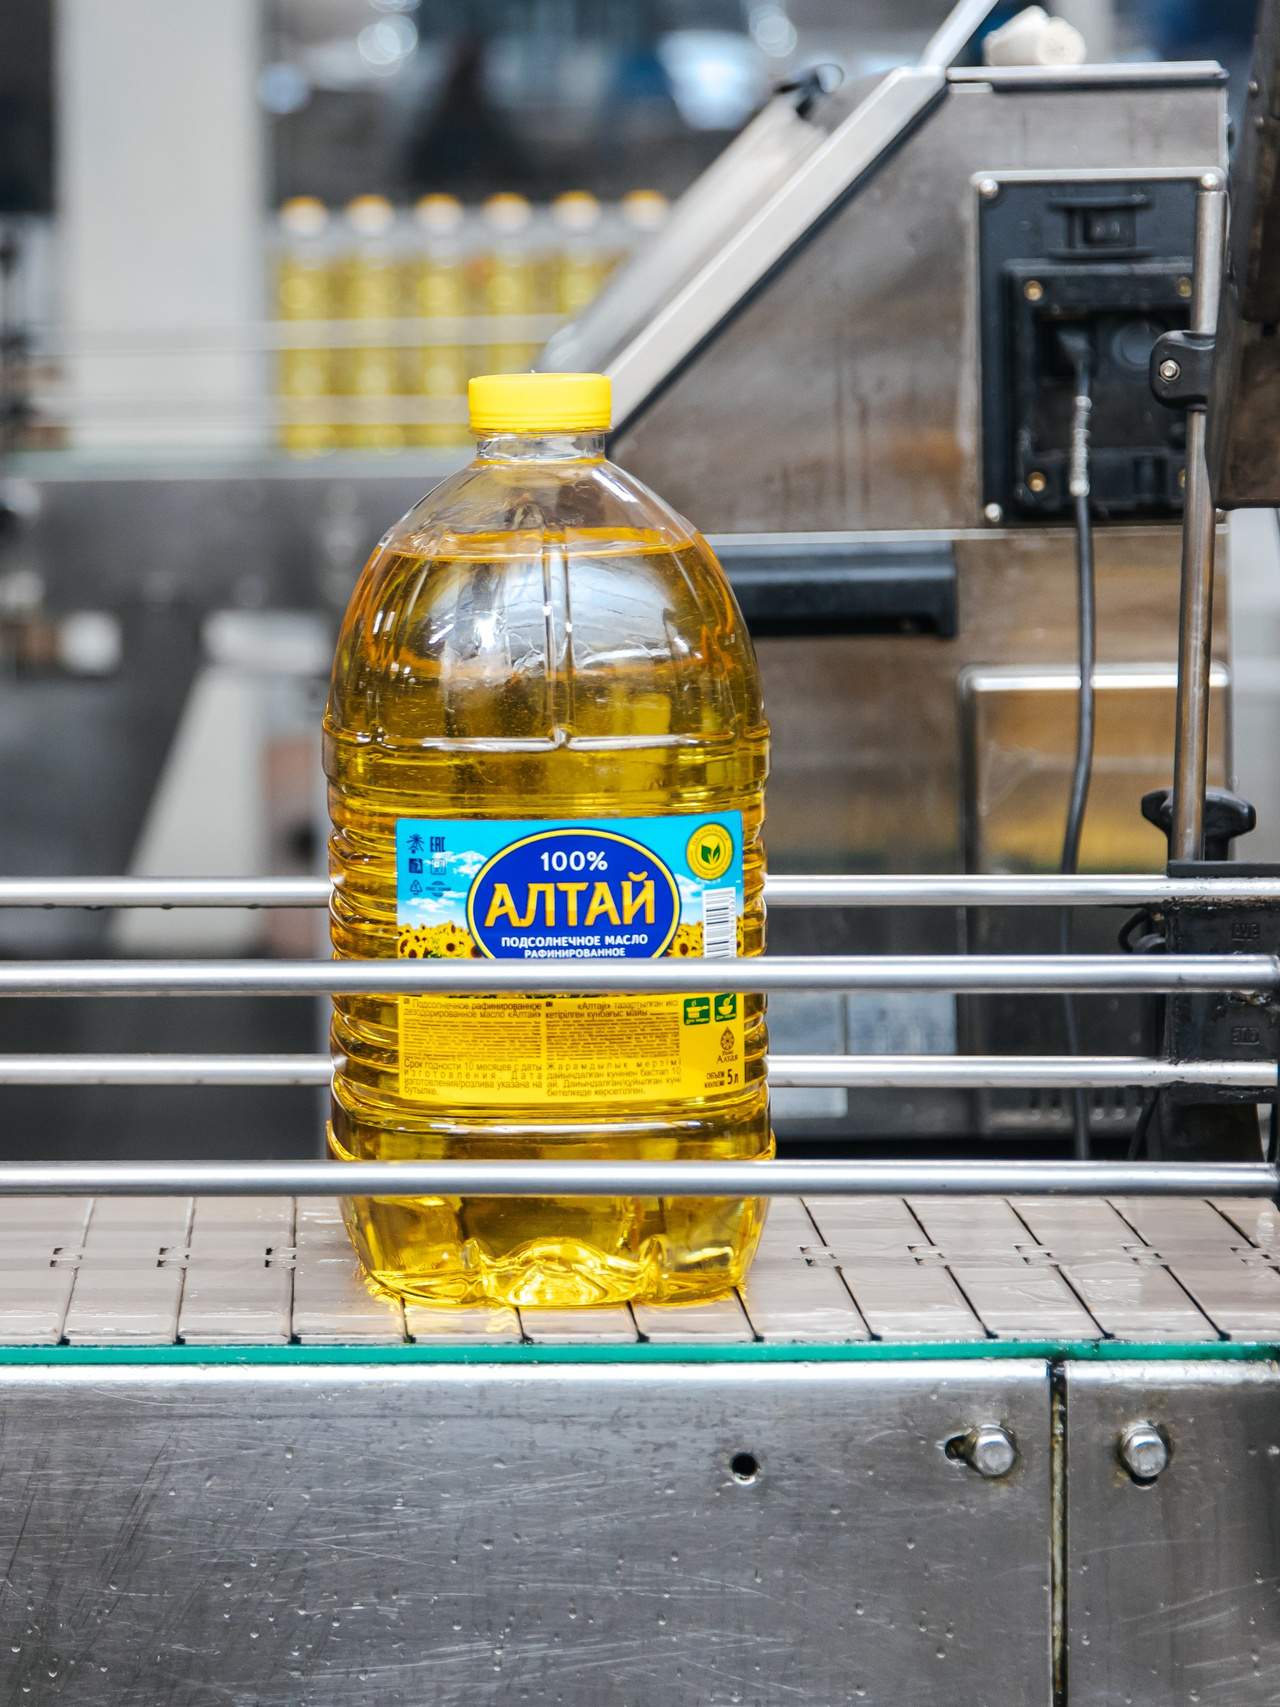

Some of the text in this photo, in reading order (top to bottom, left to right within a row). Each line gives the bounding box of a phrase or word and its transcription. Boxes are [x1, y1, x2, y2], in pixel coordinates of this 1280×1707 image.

[541, 851, 608, 871] 100%
[484, 871, 655, 927] АЛТАЙ
[501, 934, 648, 948] ПОДСОЛНЕЧНОЕ МАСЛО
[524, 948, 625, 958] РАФИНИРОВАННОЕ
[404, 1059, 422, 1070] Срок
[425, 1062, 461, 1071] годности
[464, 1062, 473, 1070] 10
[476, 1064, 511, 1072] месяцев
[672, 1067, 681, 1075] 10
[512, 1070, 542, 1080] Дата
[728, 1069, 732, 1084] 5
[497, 1081, 530, 1090] указана
